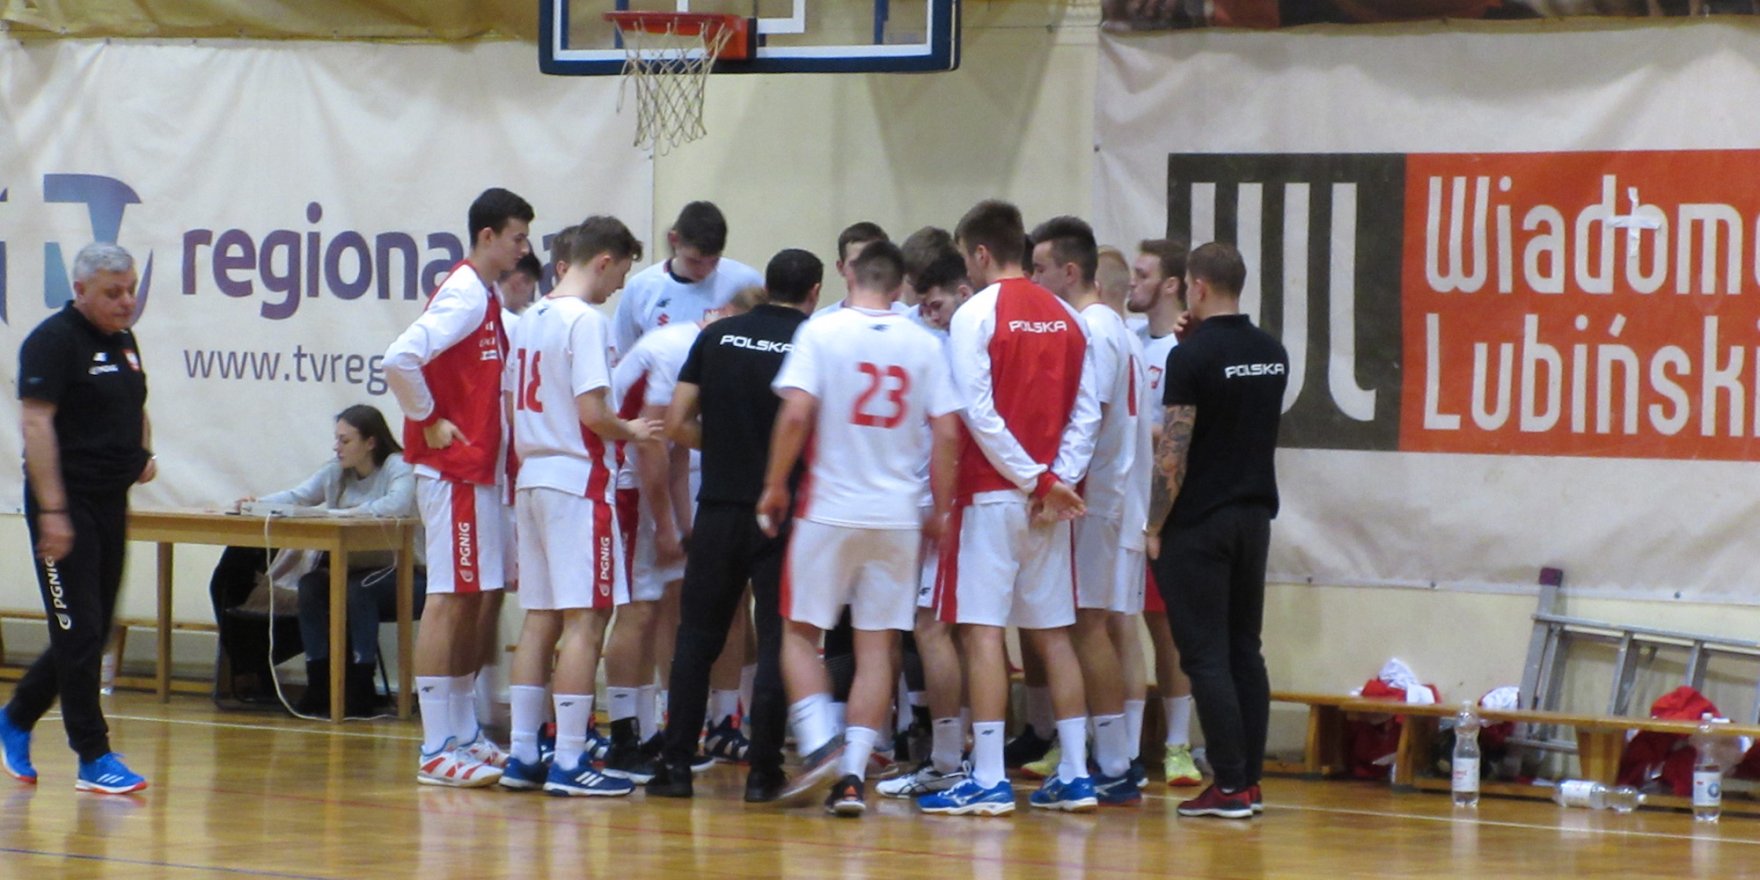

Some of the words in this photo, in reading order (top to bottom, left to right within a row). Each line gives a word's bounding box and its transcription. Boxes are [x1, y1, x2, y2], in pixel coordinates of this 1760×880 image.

[1424, 174, 1760, 294] Wiadom
[1008, 319, 1068, 334] POLSKA
[720, 335, 796, 353] POLSKA
[184, 346, 390, 396] www.tvreg
[1225, 363, 1285, 379] POLSKA
[850, 362, 911, 429] 23
